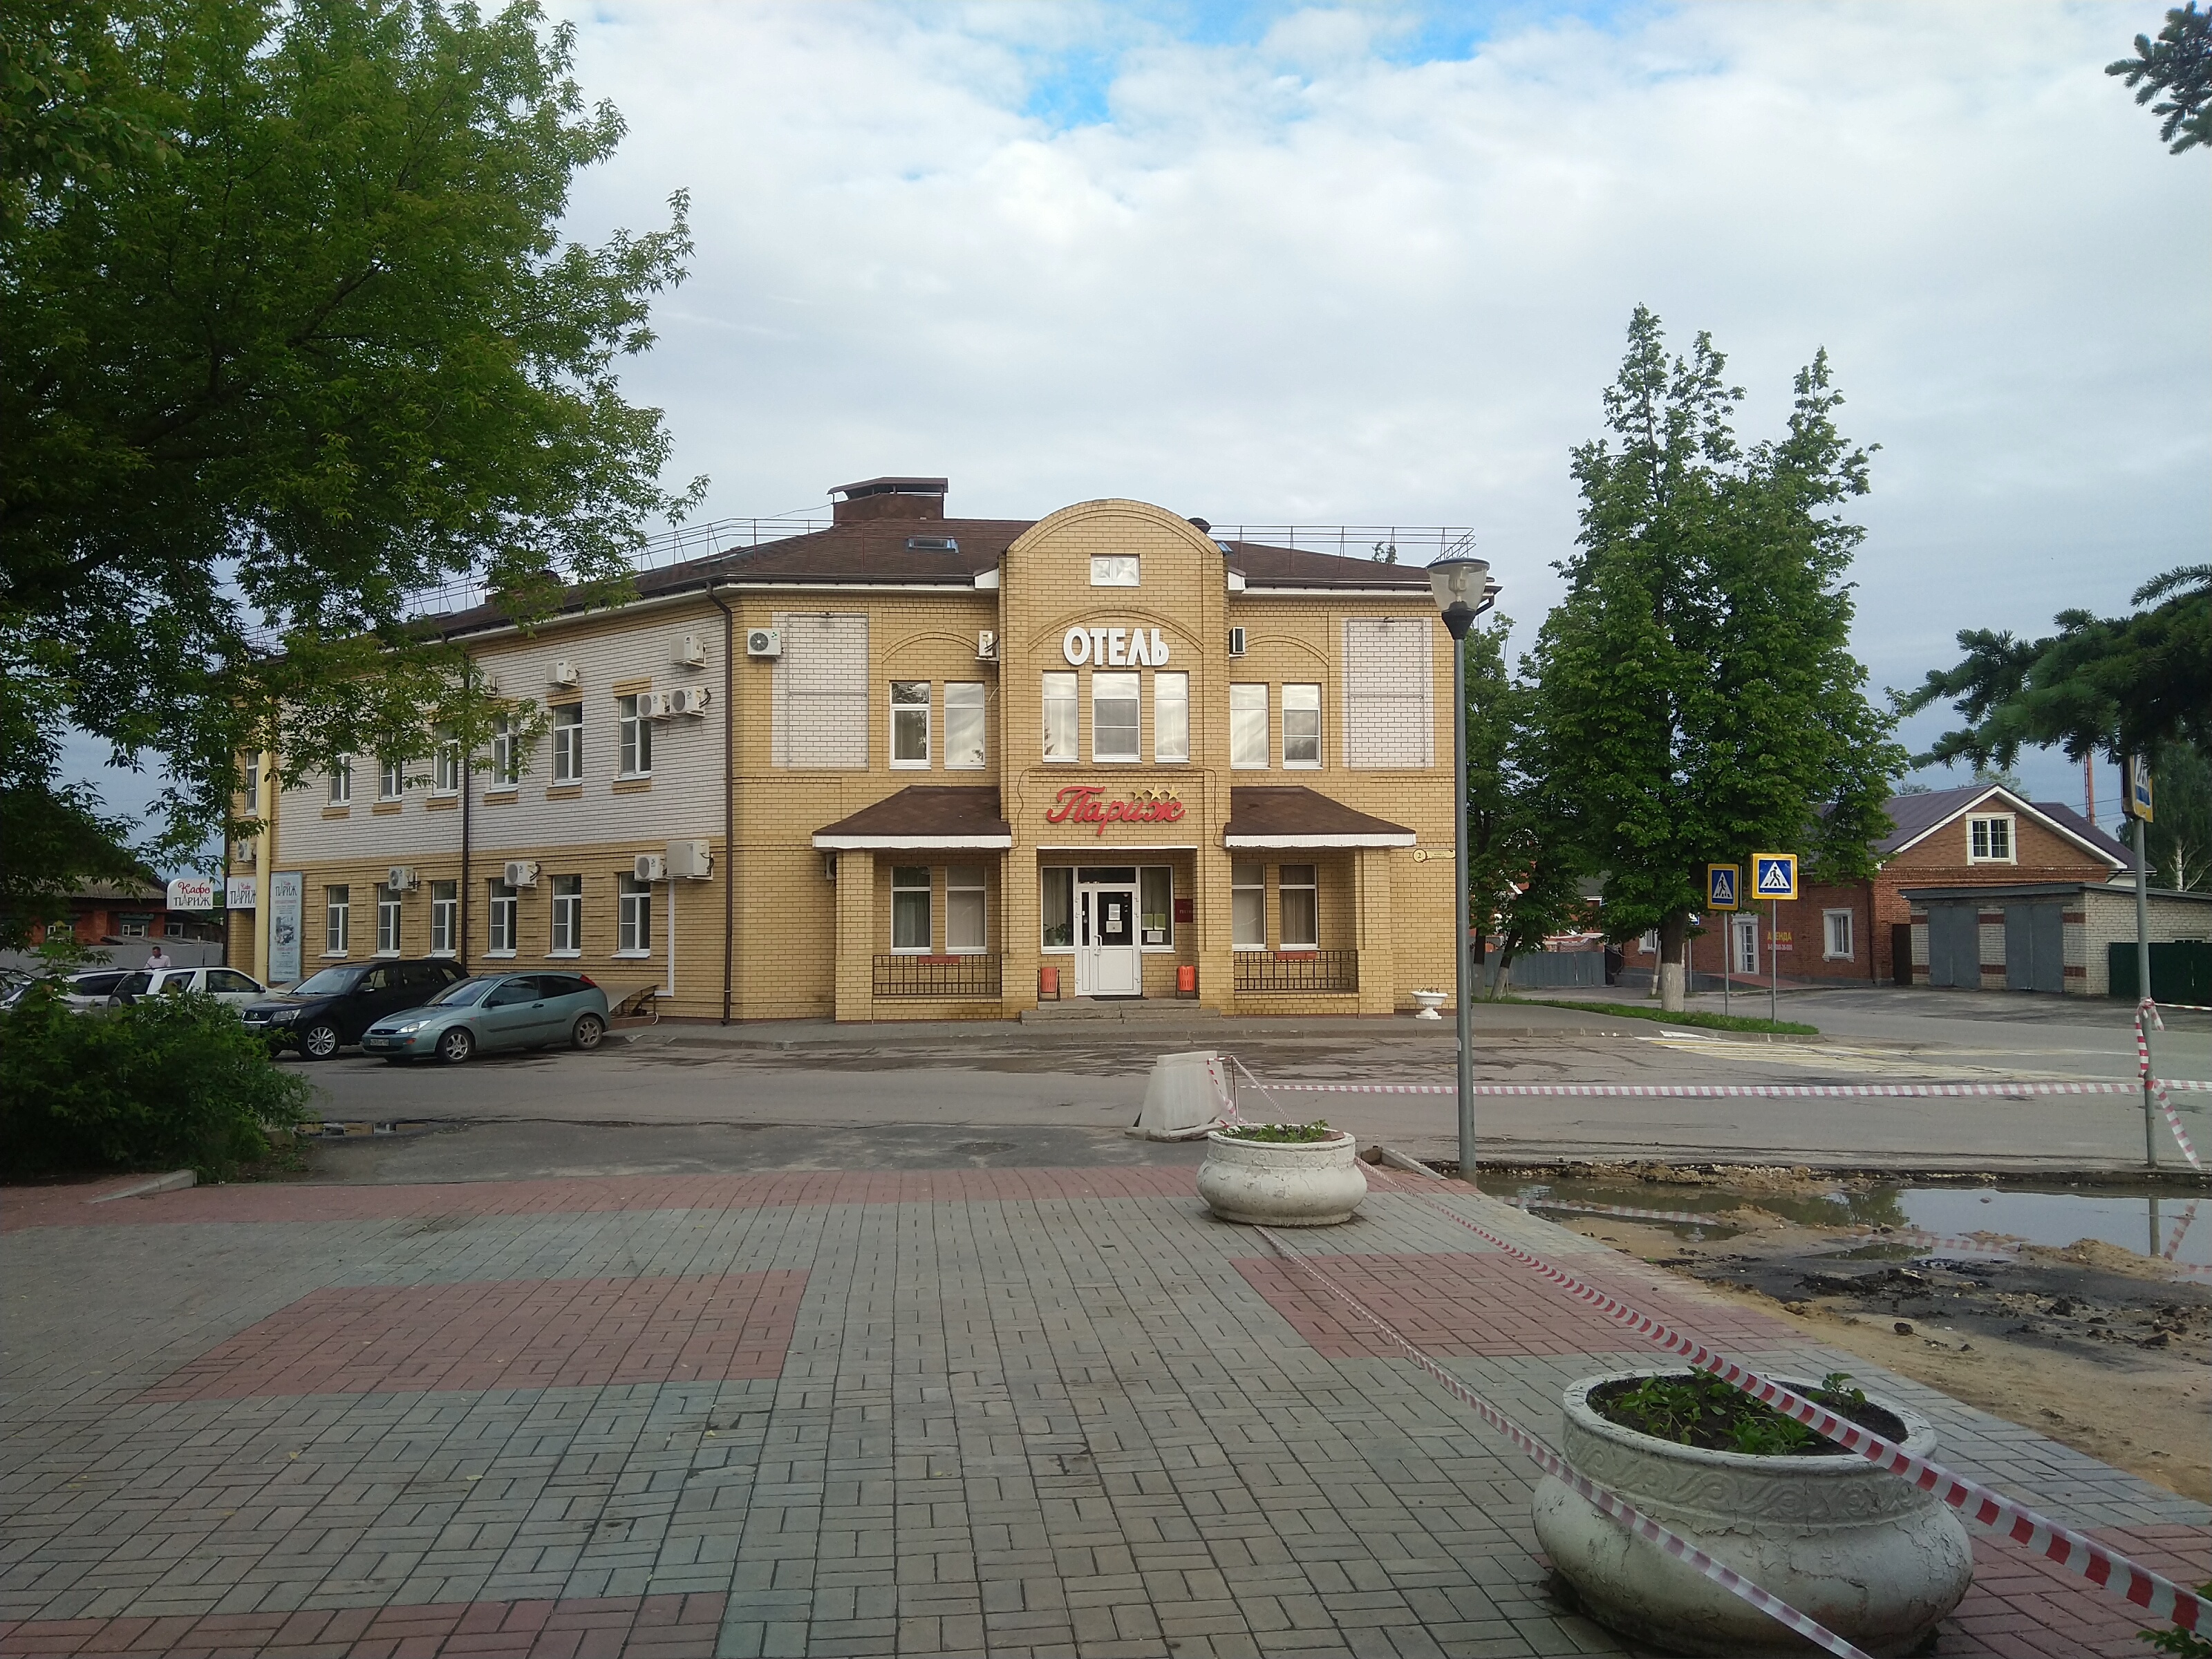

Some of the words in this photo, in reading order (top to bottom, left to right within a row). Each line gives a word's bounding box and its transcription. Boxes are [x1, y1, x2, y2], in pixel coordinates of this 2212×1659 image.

[1063, 627, 1170, 666] ОТЕЛЬ
[1047, 785, 1186, 836] Париж
[178, 881, 210, 897] Кафе
[174, 895, 211, 906] ПАРИЖ
[1768, 931, 1792, 941] АЕНДА
